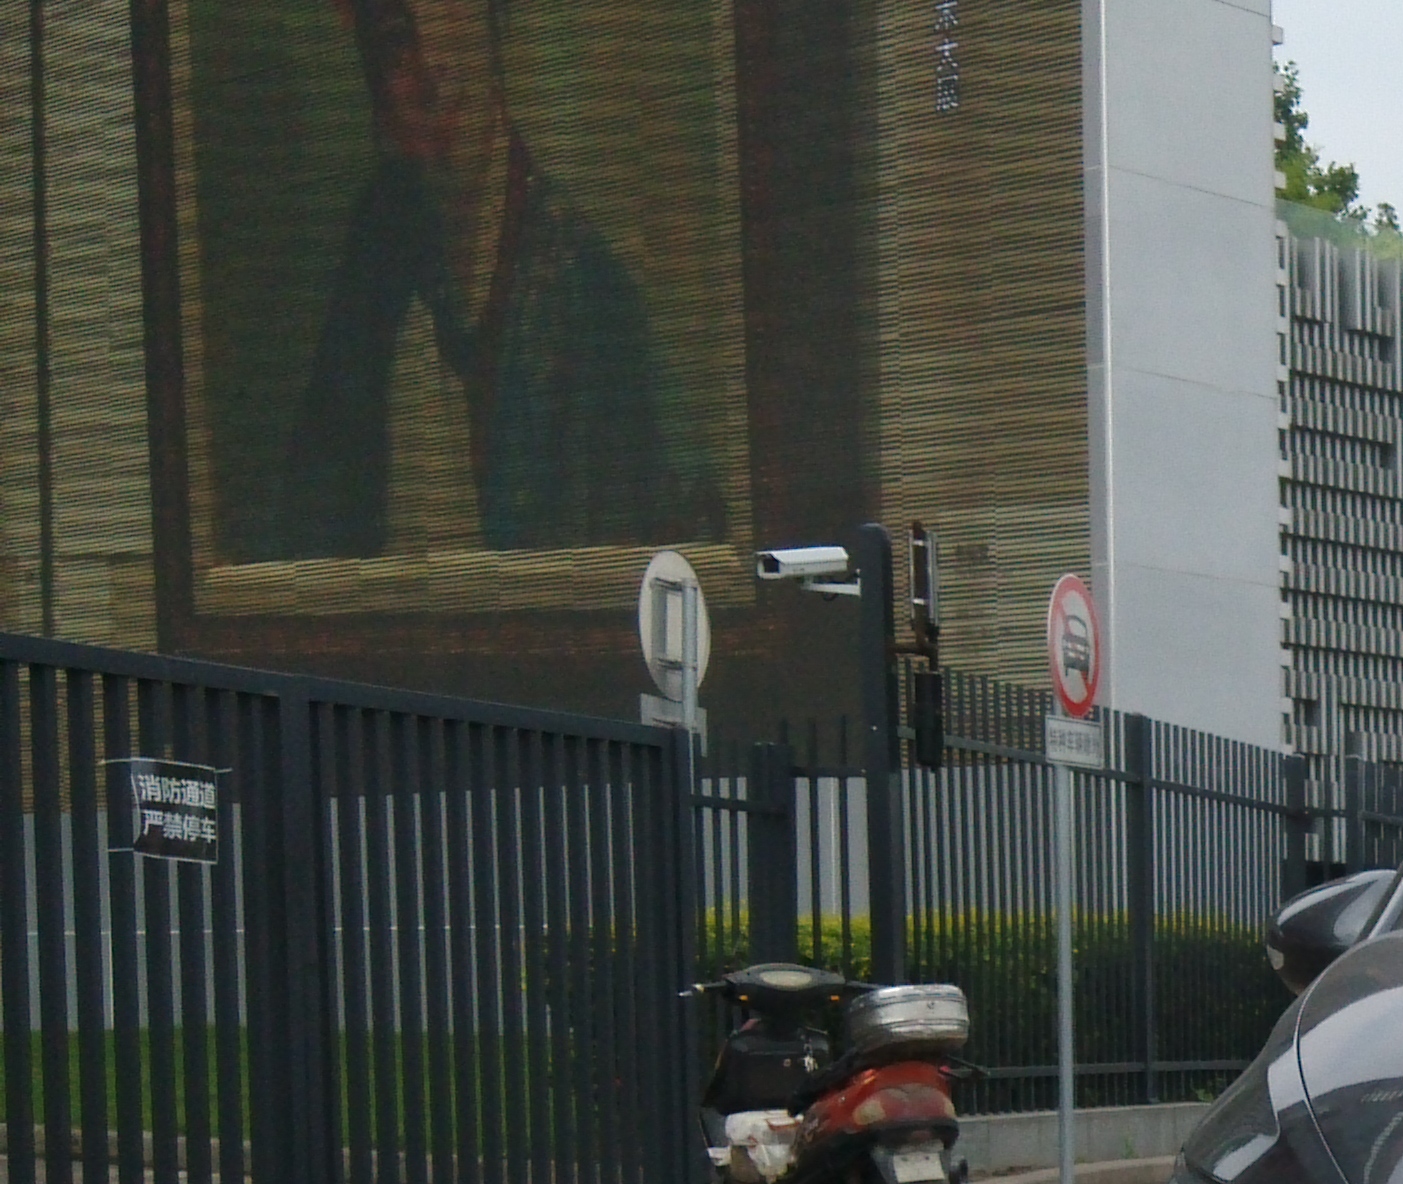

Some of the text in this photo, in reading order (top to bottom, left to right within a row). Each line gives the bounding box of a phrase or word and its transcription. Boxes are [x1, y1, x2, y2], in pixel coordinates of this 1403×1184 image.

[137, 773, 216, 809] 消防通道
[141, 810, 217, 844] 严禁停车
